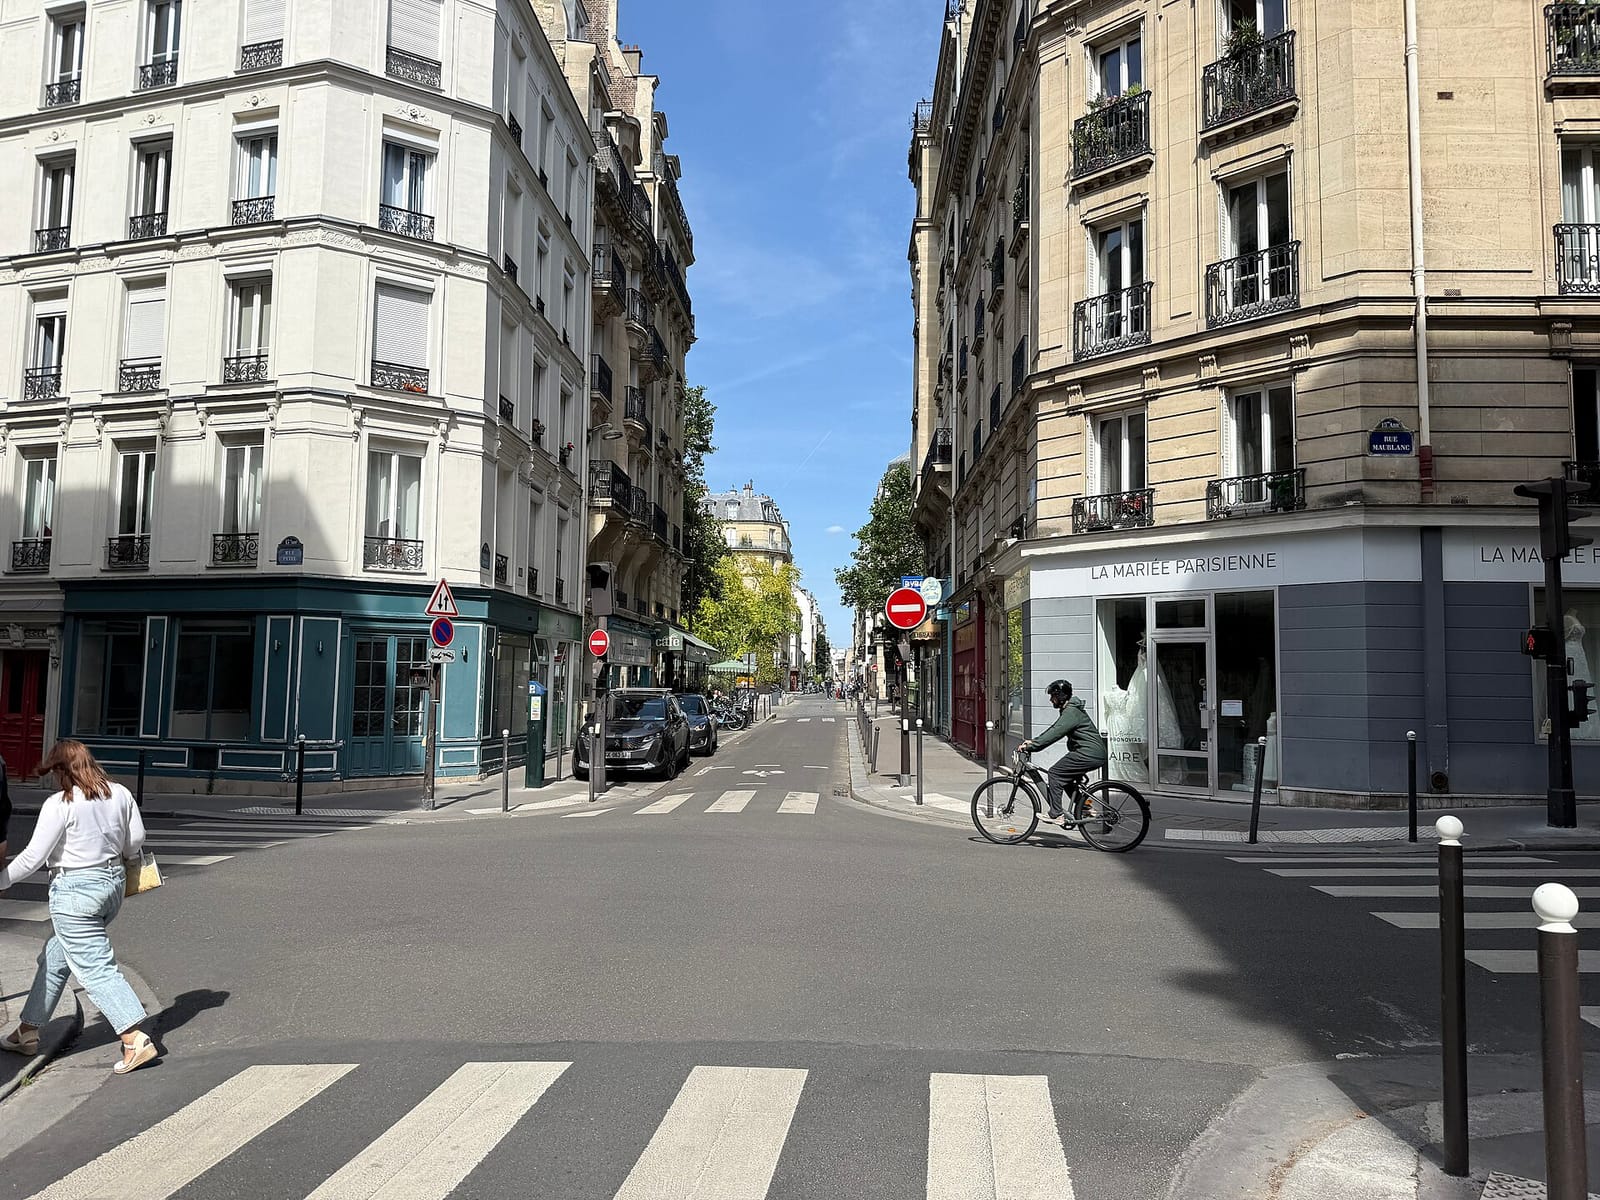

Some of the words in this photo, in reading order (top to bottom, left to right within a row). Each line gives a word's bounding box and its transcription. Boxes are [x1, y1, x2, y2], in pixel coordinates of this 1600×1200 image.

[1383, 435, 1399, 443] RUE
[1480, 546, 1505, 563] LA
[1511, 546, 1586, 564] MAE
[1091, 566, 1109, 580] LA
[1113, 558, 1171, 579] MARIÉE
[1175, 552, 1277, 574] PARISIENNE
[655, 634, 680, 647] café
[1109, 751, 1141, 763] AIRE
